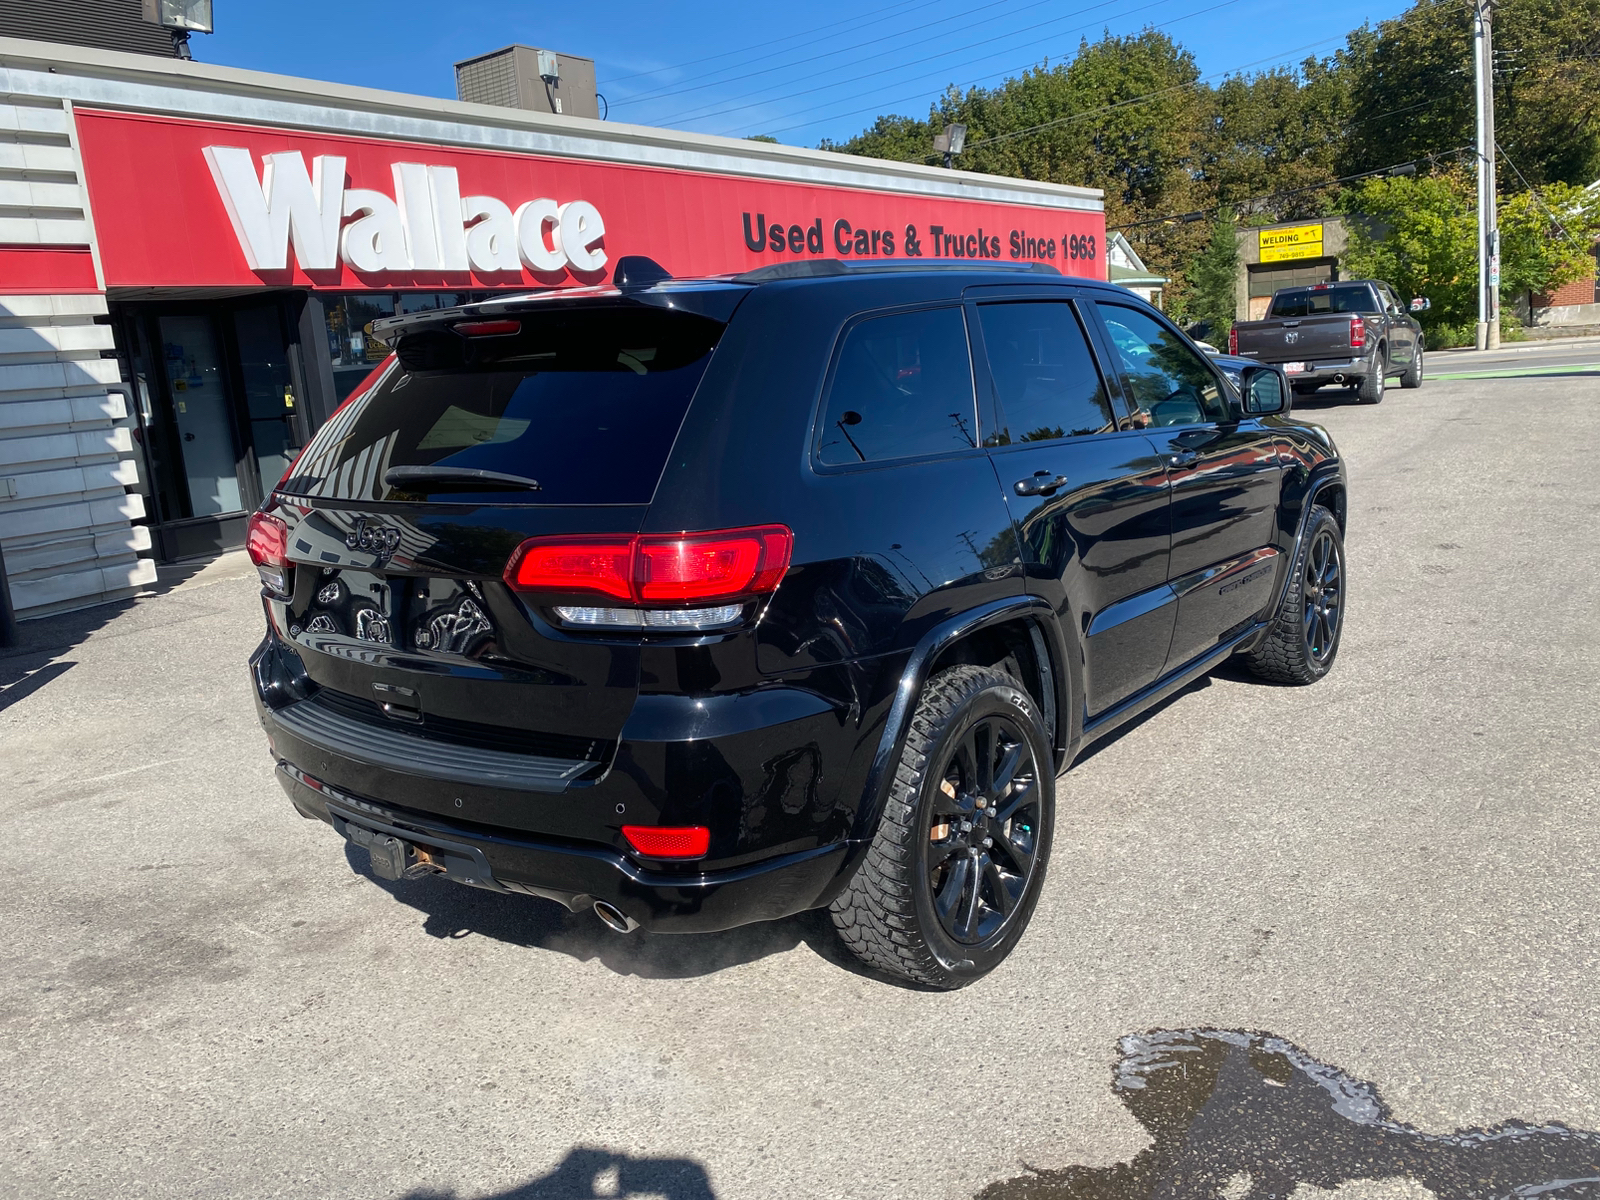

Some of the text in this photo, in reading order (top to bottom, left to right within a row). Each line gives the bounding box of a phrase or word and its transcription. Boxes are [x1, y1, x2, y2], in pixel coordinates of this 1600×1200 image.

[201, 145, 608, 272] Wallace
[742, 212, 1096, 260] Used Cars & Trucks Since 1963
[1262, 234, 1299, 245] WELDING
[346, 518, 401, 561] Jeep
